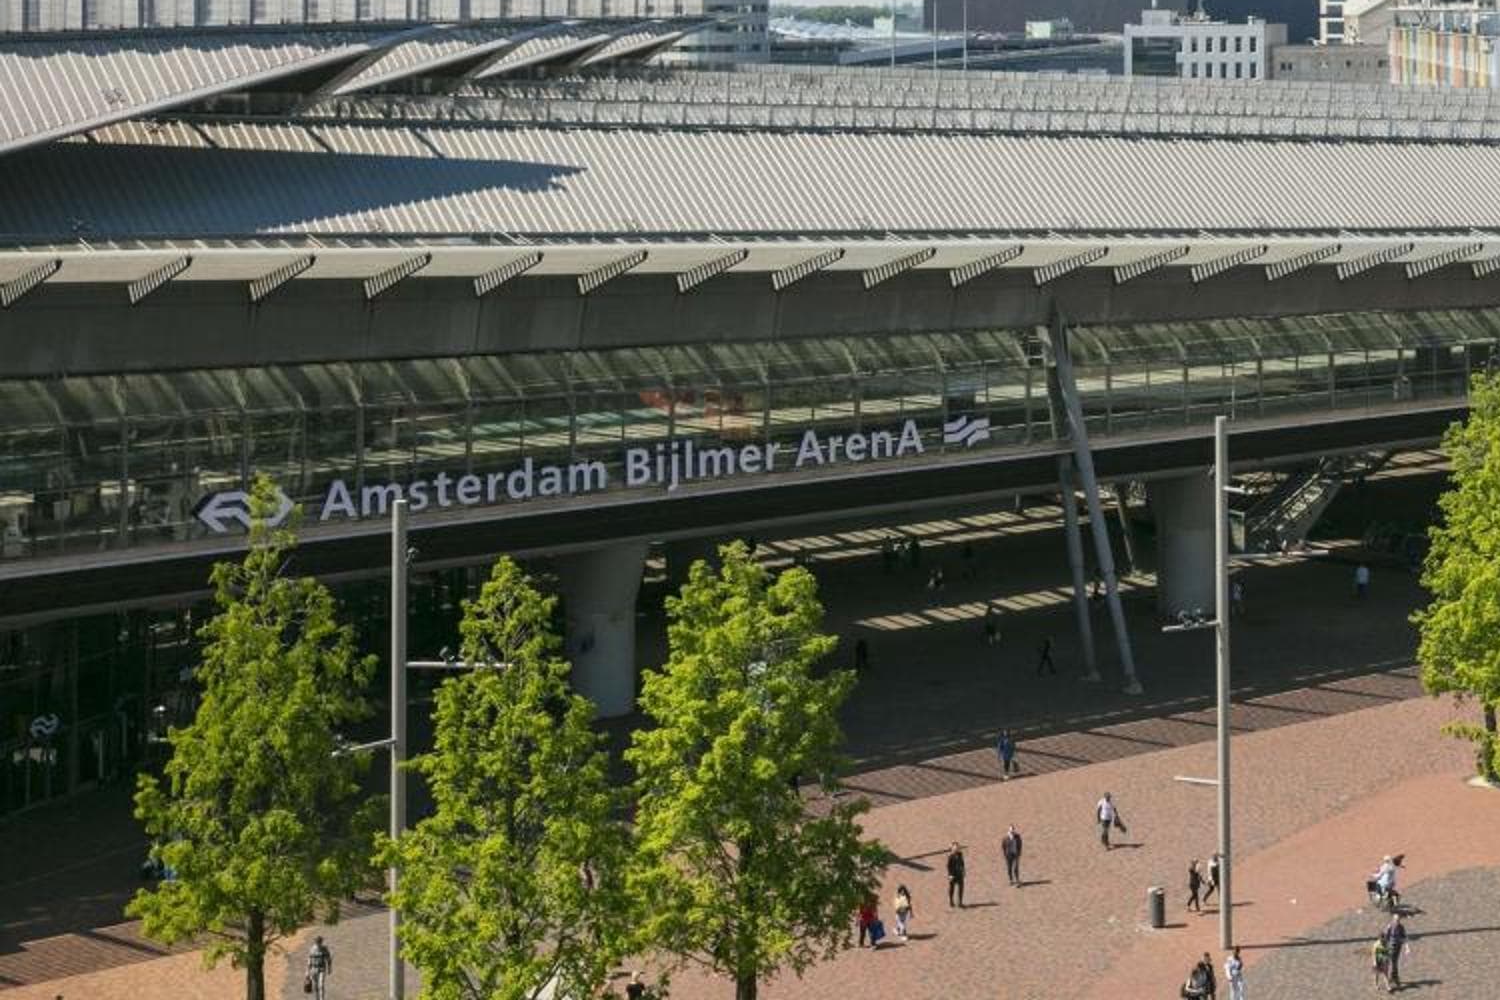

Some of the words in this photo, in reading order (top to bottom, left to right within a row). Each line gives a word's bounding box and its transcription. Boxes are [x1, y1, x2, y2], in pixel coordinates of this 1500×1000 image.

[319, 456, 607, 521] Amsterdam
[625, 439, 782, 491] Bijlmer
[795, 419, 926, 468] ArenA
